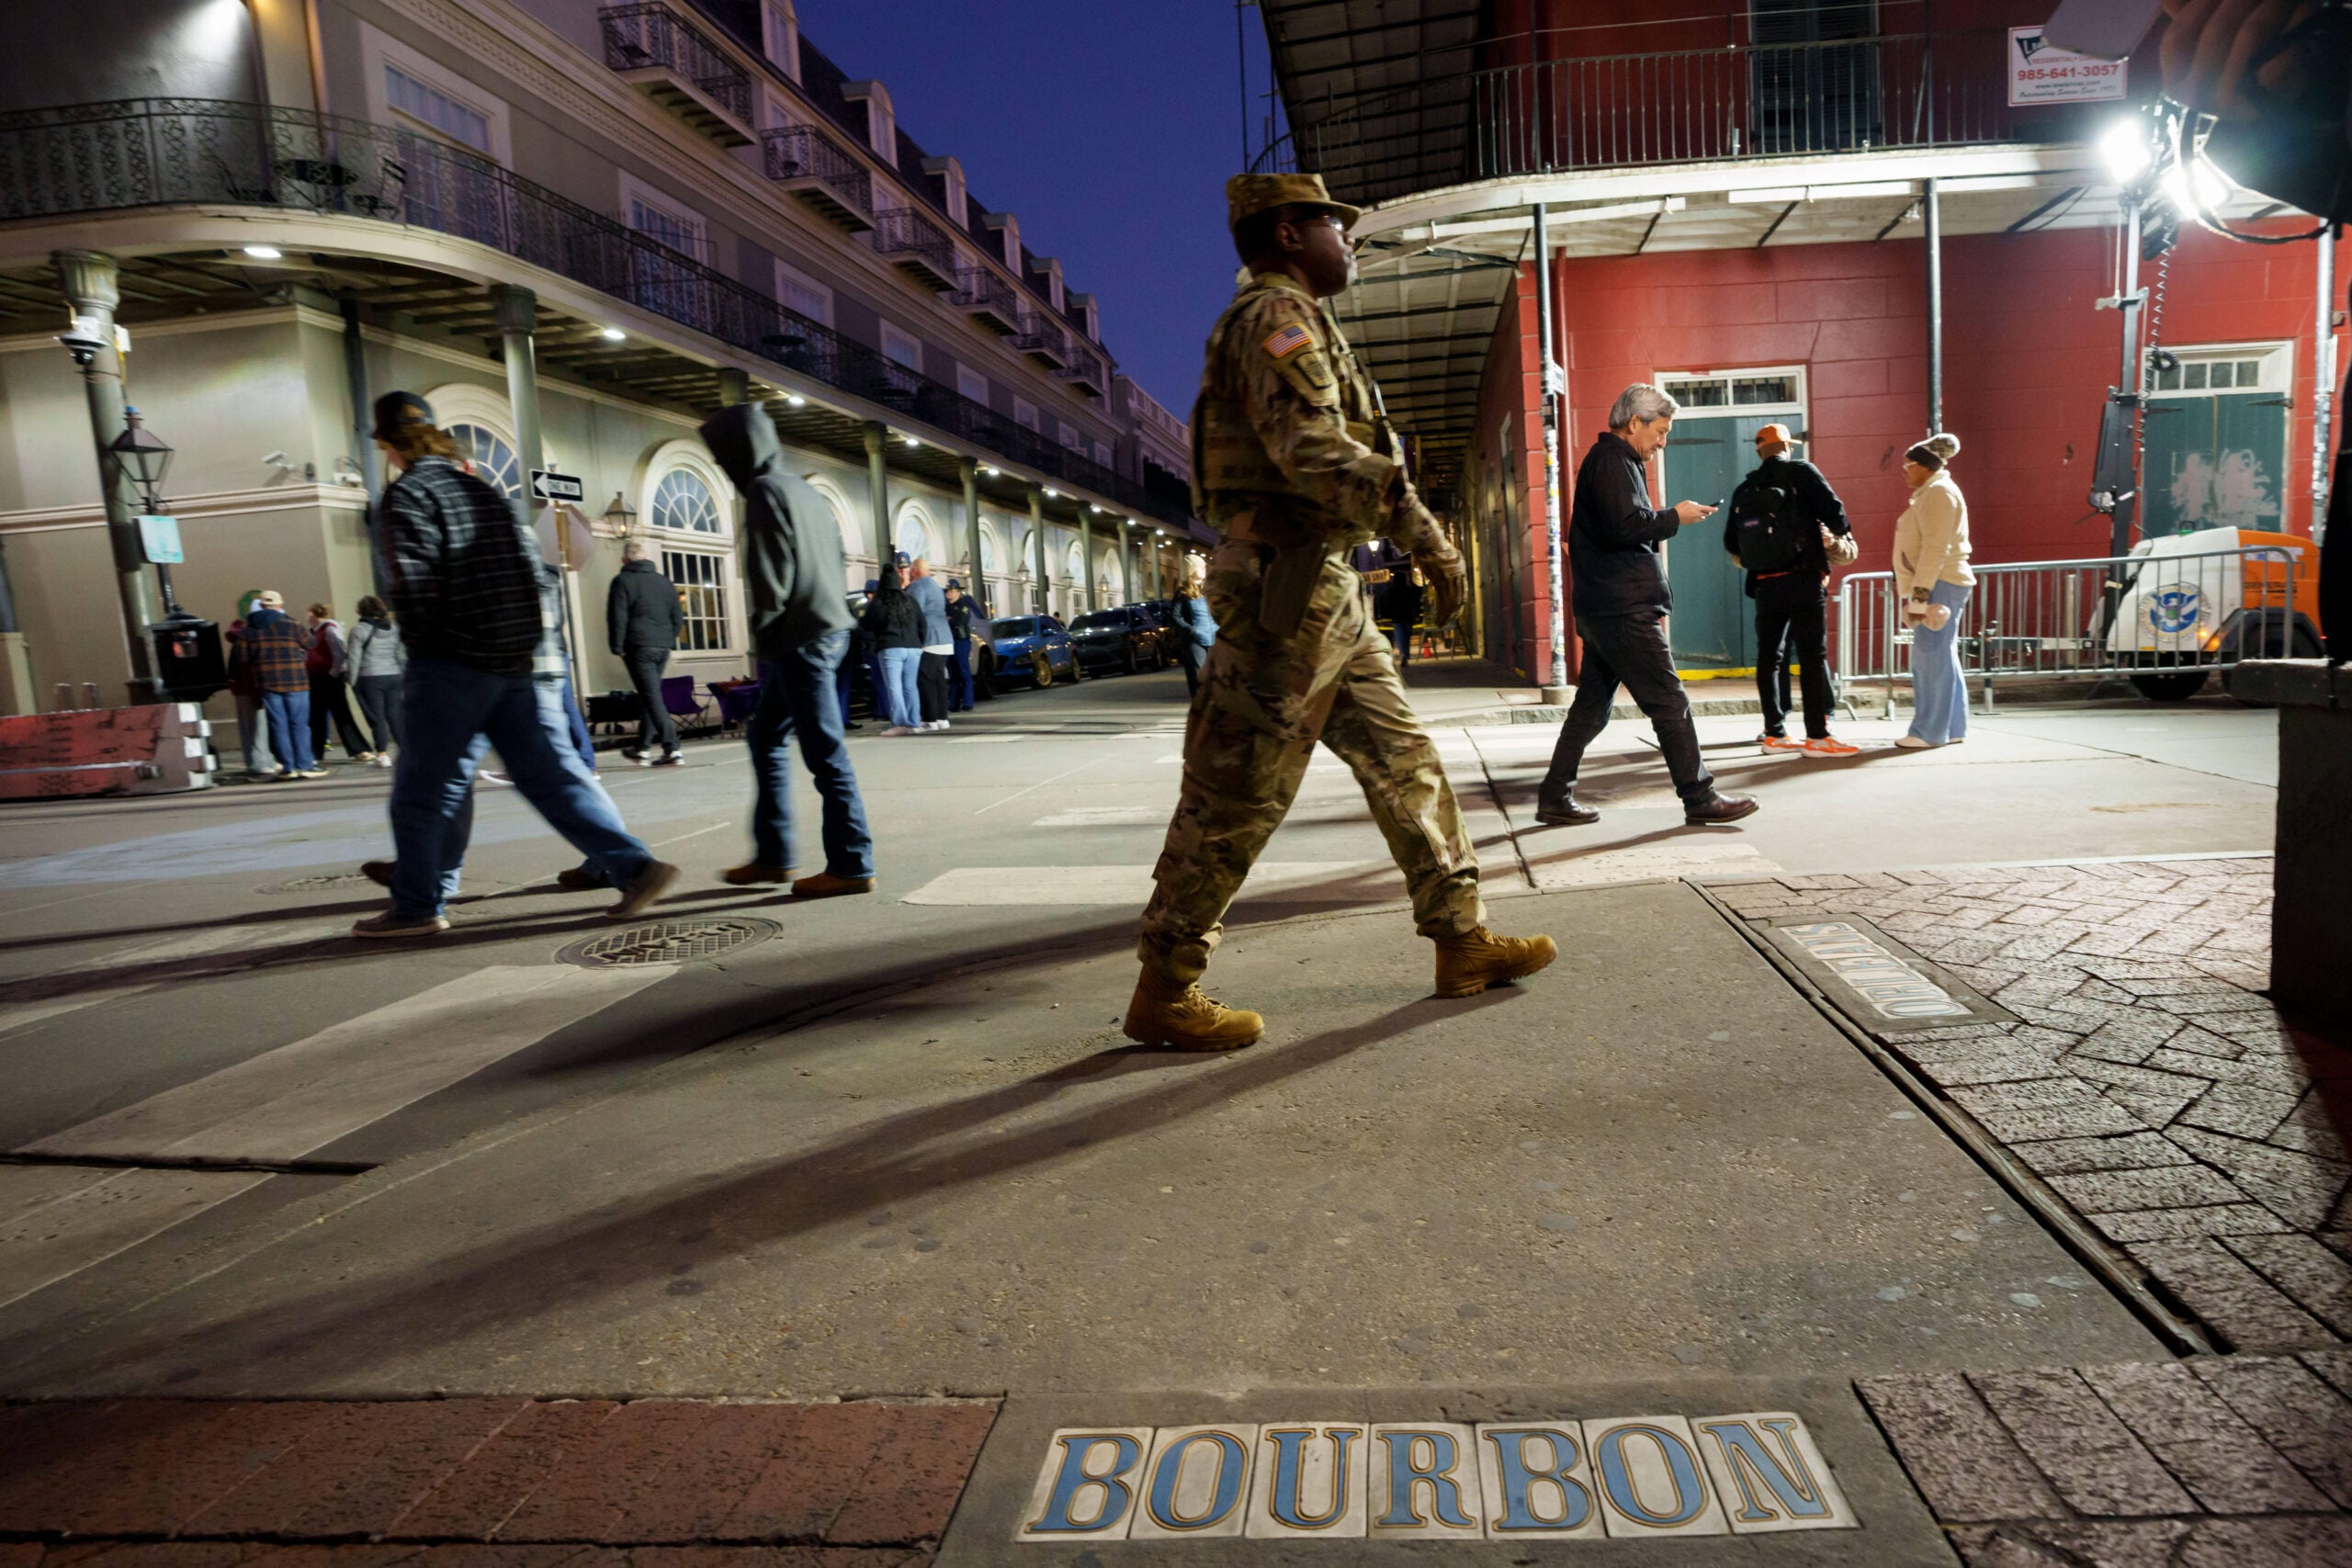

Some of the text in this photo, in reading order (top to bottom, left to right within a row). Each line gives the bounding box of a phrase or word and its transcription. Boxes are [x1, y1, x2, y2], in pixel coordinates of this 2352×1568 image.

[2018, 65, 2120, 81] 985-641-3057
[548, 479, 578, 494] ONE WAY
[1791, 922, 1963, 1017] ORLEANS
[1023, 1418, 1834, 1534] BOURBON
